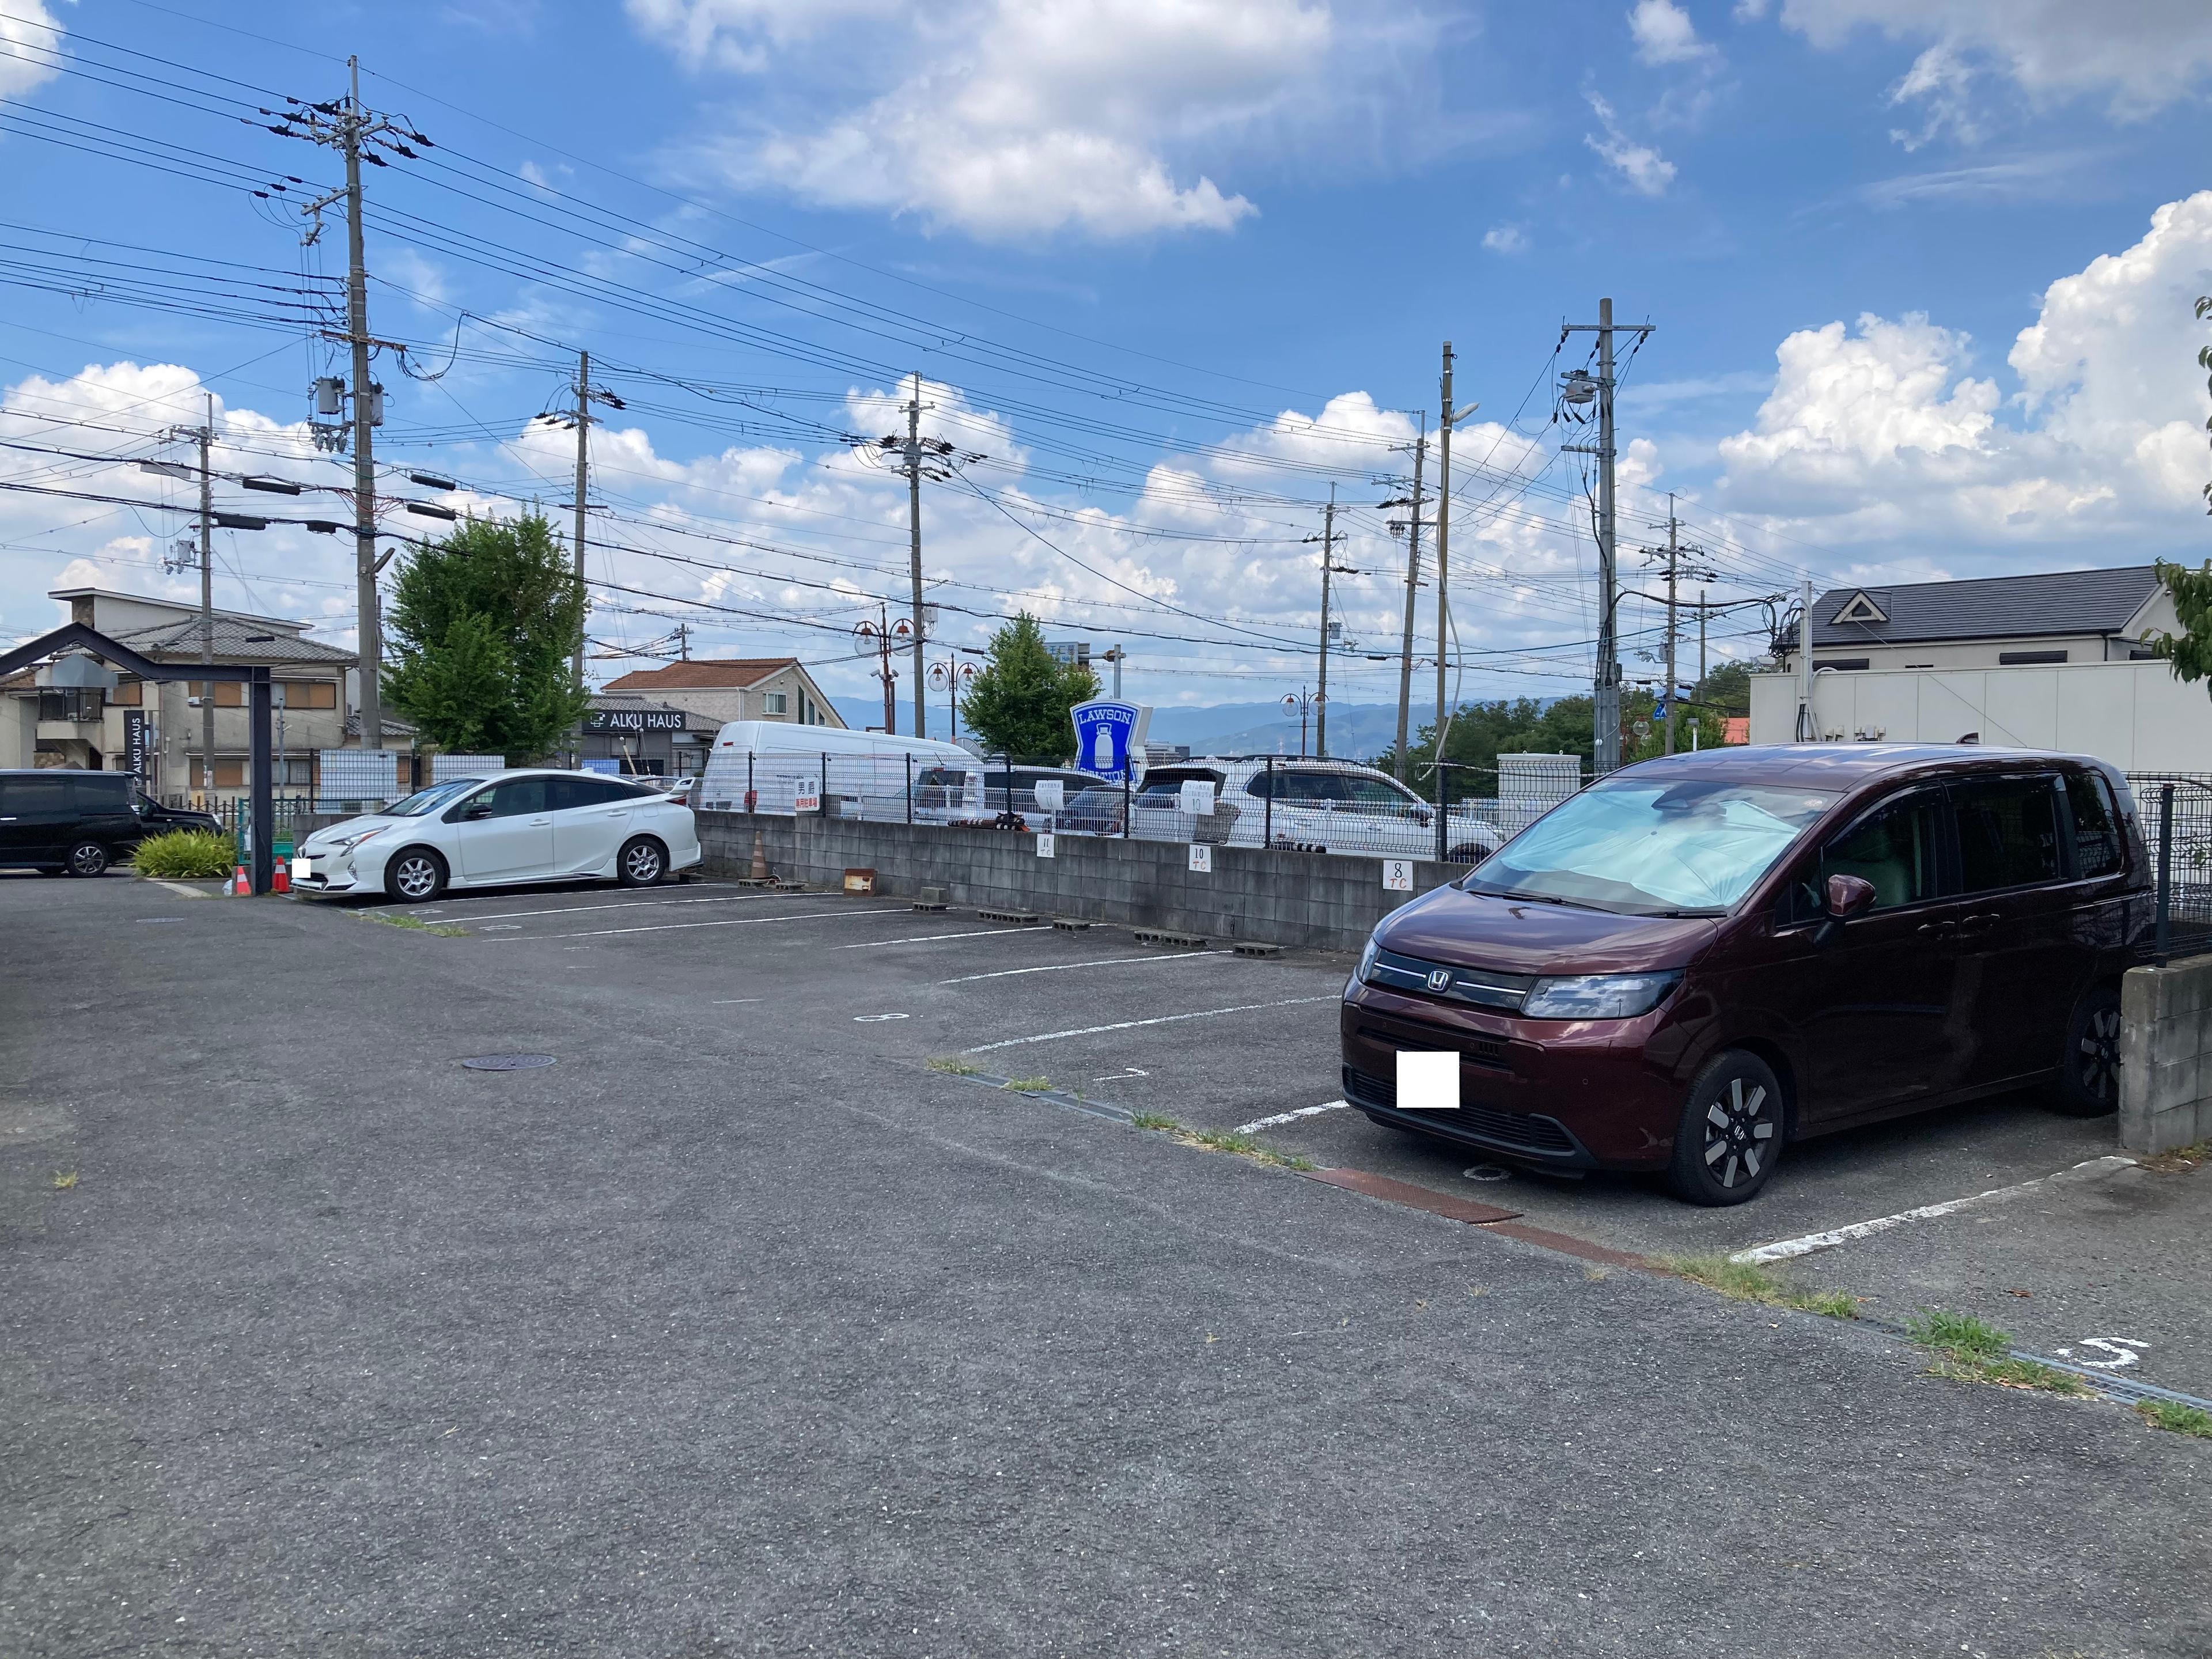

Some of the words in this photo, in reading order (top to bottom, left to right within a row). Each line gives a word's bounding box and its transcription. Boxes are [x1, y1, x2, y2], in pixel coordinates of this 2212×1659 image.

[610, 713, 642, 728] ALKU
[647, 714, 681, 729] HAUS
[1078, 709, 1132, 725] LAWSON
[132, 718, 141, 745] HAUS
[133, 749, 142, 773] ALKU
[798, 781, 815, 794] 男爵
[1046, 796, 1053, 807] 11
[1192, 798, 1201, 811] 10
[1043, 838, 1050, 847] 11
[1195, 848, 1204, 859] 10
[1193, 861, 1206, 870] TC
[1395, 863, 1402, 878] 8
[1389, 878, 1407, 889] TC
